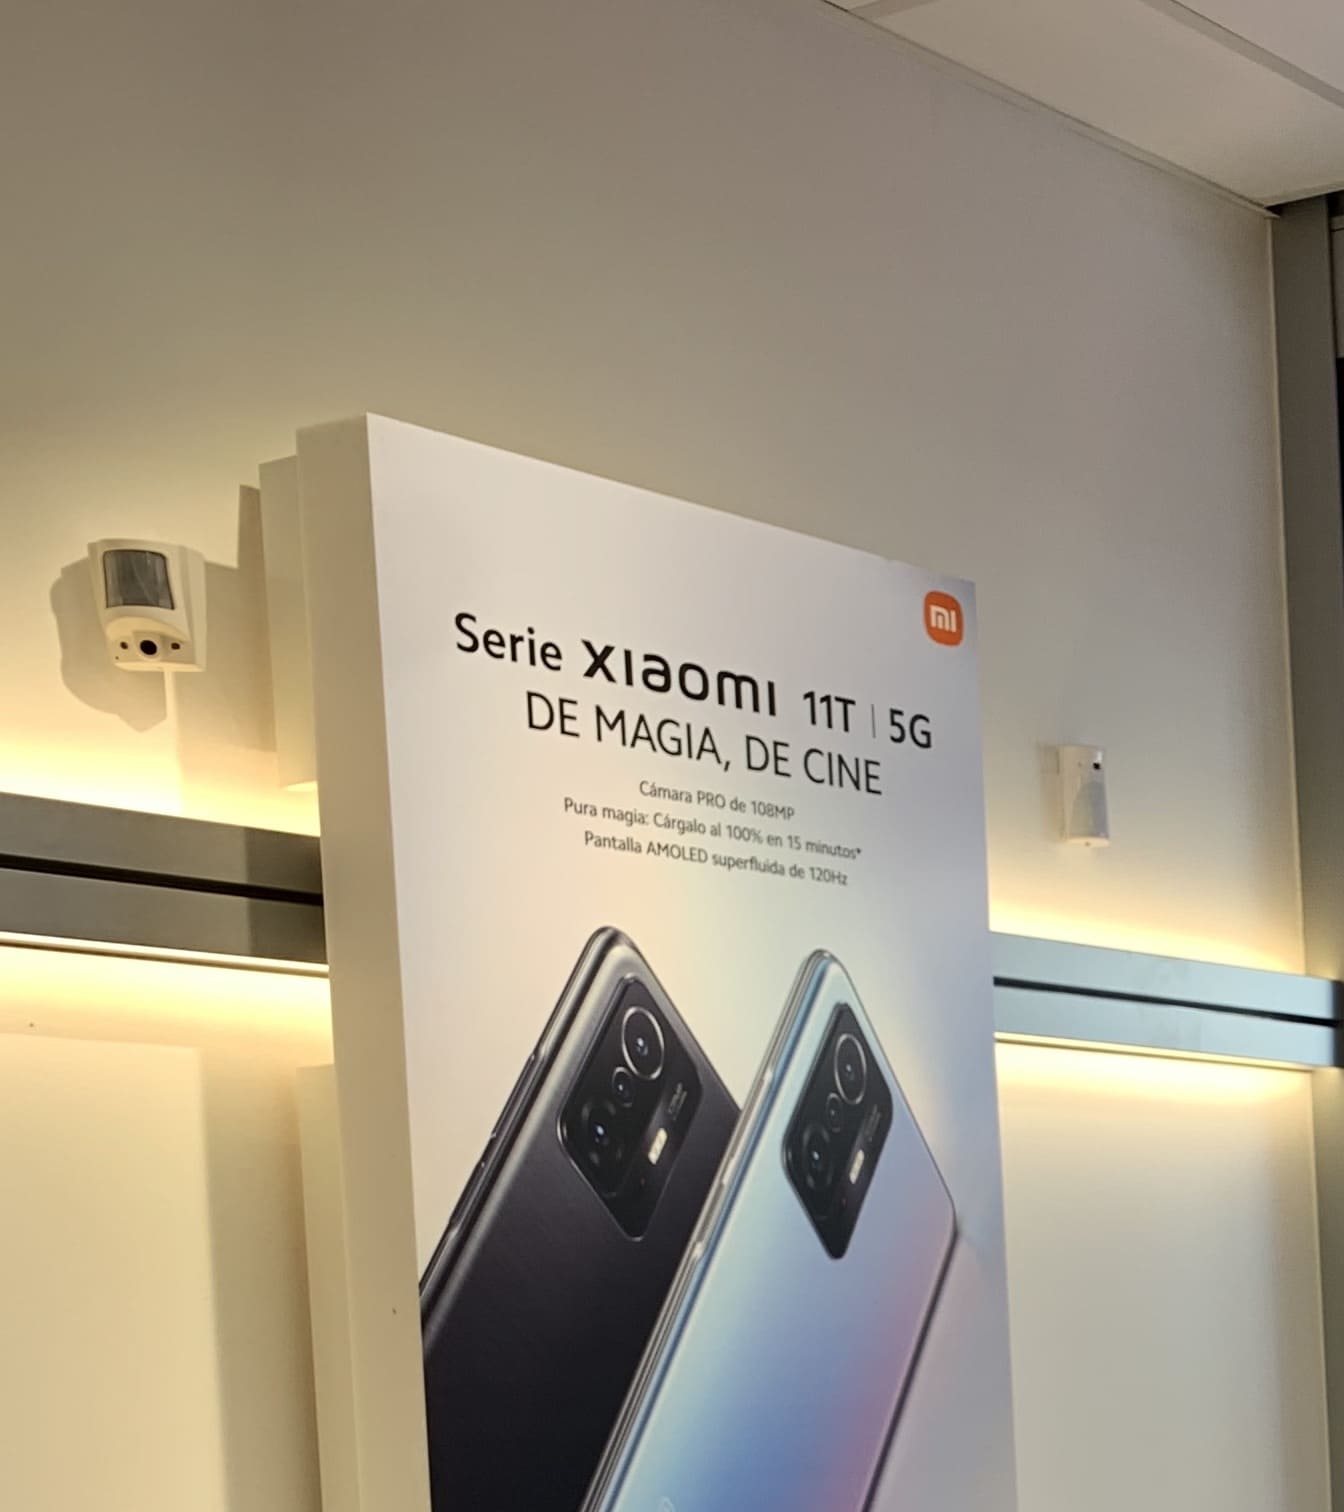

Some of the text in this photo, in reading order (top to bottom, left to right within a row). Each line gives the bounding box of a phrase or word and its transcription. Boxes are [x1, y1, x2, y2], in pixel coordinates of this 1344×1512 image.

[454, 612, 563, 671] Serie
[803, 691, 856, 733] 11T
[889, 708, 933, 749] 5G
[526, 690, 882, 795] DE MAGIA, DE CINE
[563, 797, 598, 817] Pura
[602, 806, 650, 827] magia:
[653, 812, 706, 836] Cárgalo
[709, 822, 721, 837] al
[726, 824, 763, 845] 100%
[766, 833, 783, 848] en
[786, 834, 802, 850] 15
[639, 780, 795, 820] Cámara PRO de 108MP
[584, 830, 848, 886] Pantalla AMOLED superfluida de 120Hz
